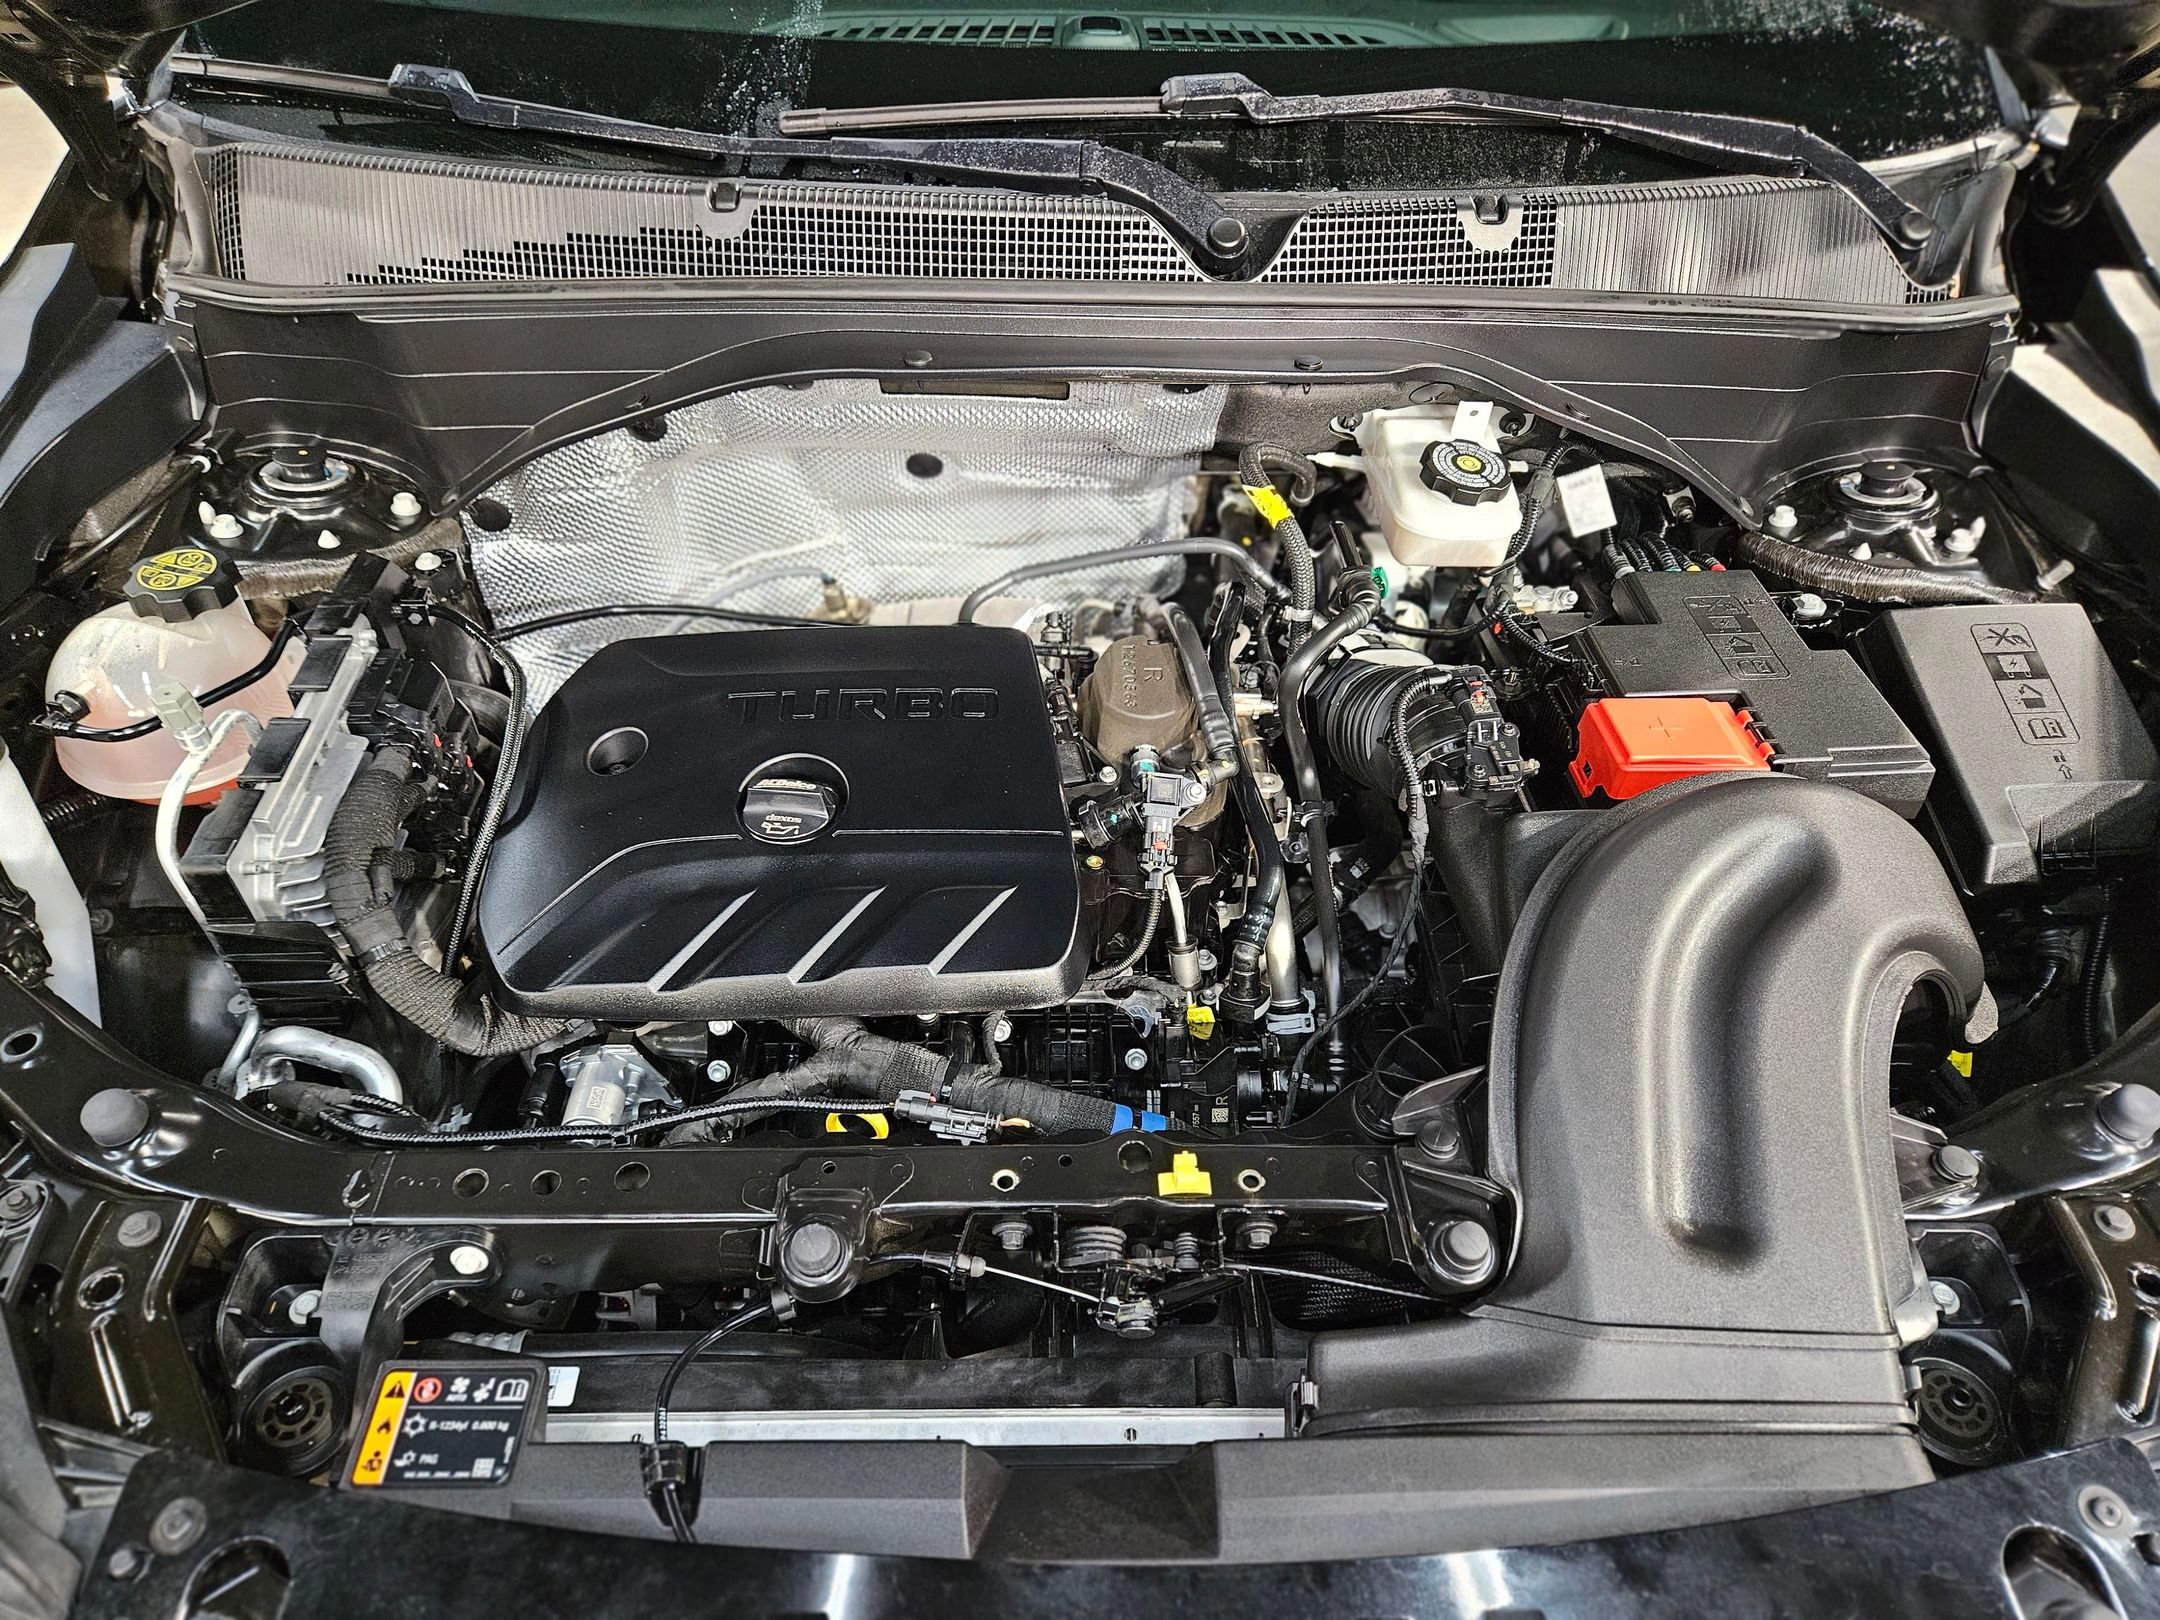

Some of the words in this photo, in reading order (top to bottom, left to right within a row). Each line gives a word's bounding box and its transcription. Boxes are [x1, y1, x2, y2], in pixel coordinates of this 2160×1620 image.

[1143, 667, 1164, 682] R
[728, 687, 999, 724] TURBO
[753, 778, 817, 791] ACDelco
[765, 813, 803, 824] dexos
[1215, 1095, 1229, 1105] R
